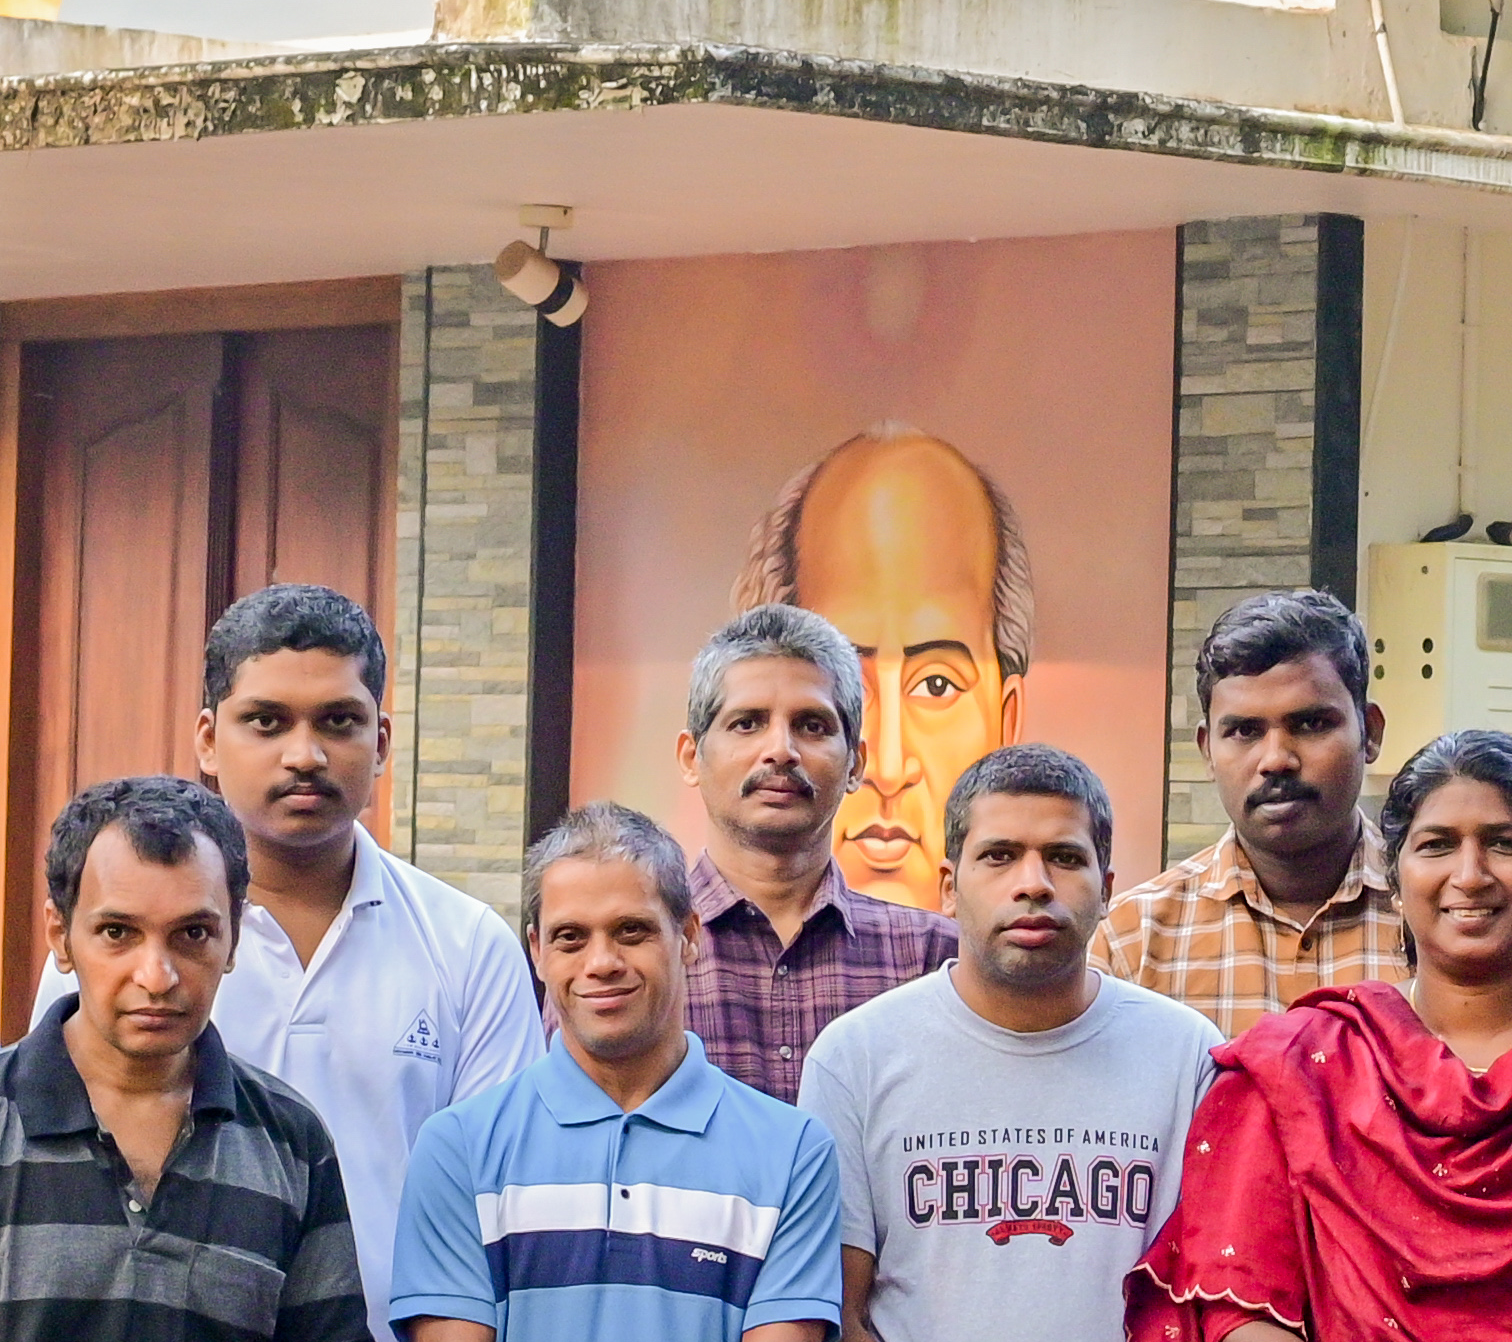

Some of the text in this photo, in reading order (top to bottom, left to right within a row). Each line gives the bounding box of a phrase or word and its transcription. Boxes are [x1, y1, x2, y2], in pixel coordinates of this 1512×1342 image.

[903, 1127, 1160, 1153] UNITED STATES OF AMERICA
[903, 1153, 1156, 1229] CHICAGO
[690, 1247, 728, 1265] sports
